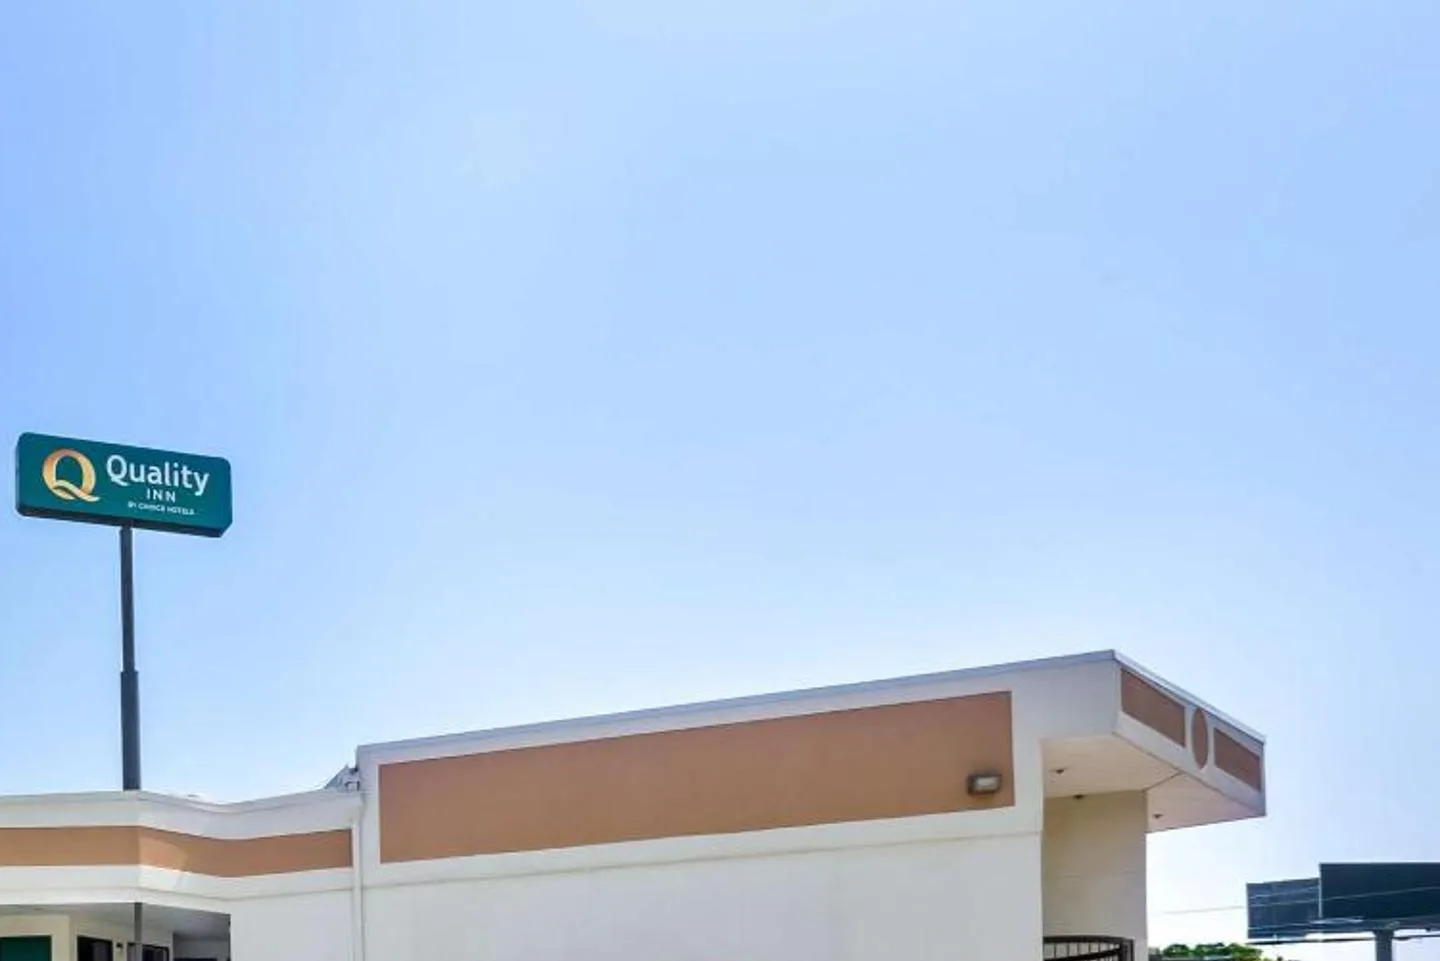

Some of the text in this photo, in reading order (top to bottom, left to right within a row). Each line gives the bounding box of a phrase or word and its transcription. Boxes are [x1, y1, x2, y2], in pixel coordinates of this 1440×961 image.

[42, 448, 101, 503] Q
[106, 454, 210, 496] Quality
[146, 487, 176, 503] INN
